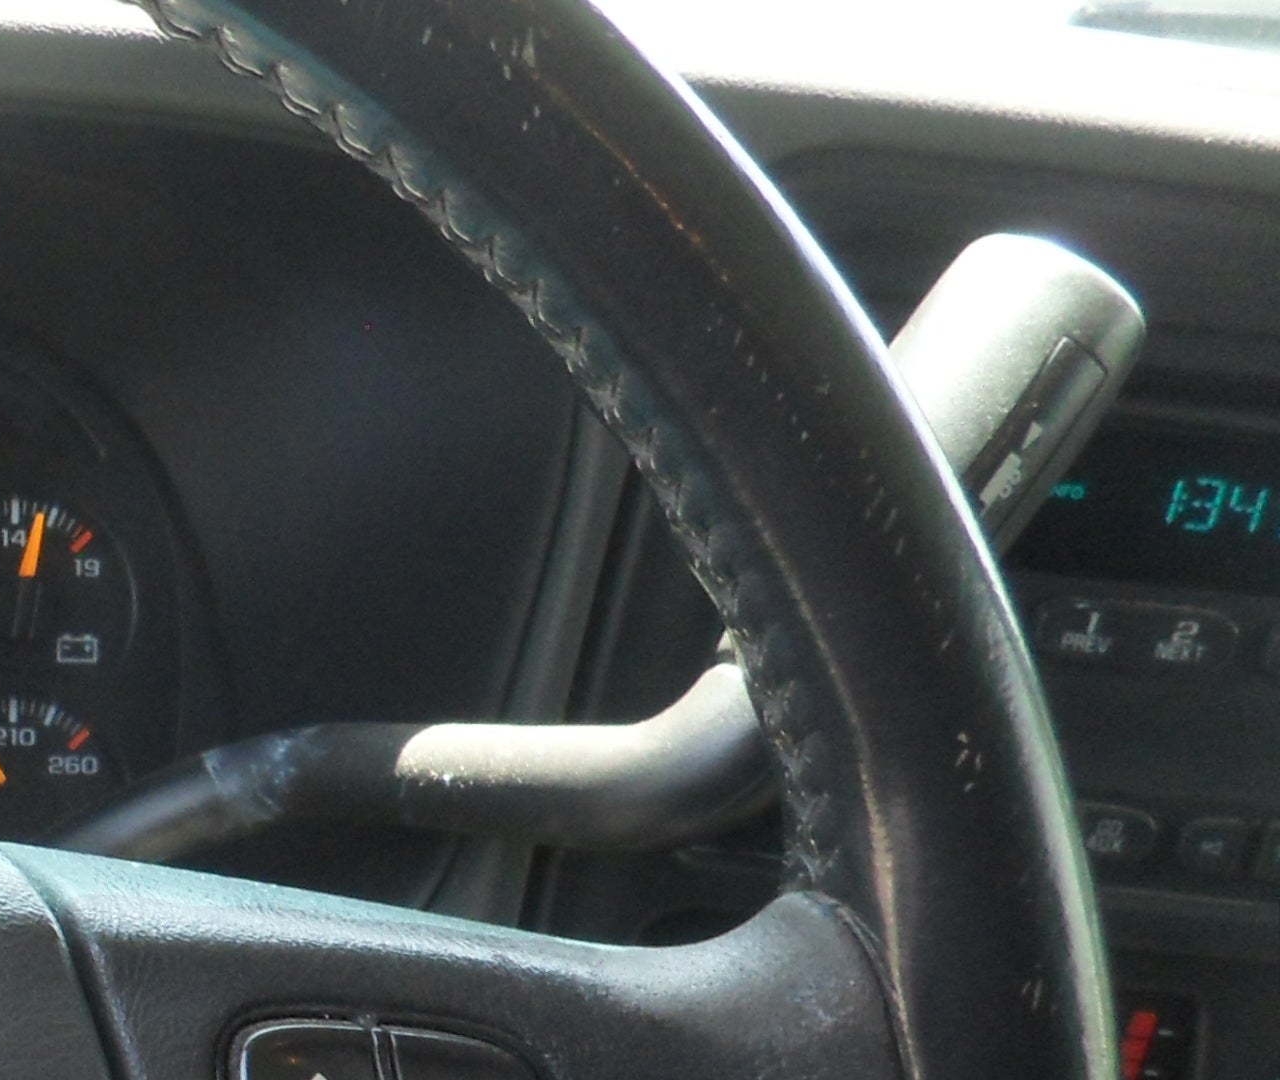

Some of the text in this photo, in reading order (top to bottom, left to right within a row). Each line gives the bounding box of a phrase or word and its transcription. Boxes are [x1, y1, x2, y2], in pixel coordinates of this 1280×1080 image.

[0, 528, 27, 547] 14
[74, 558, 101, 578] 19
[47, 756, 99, 775] 260
